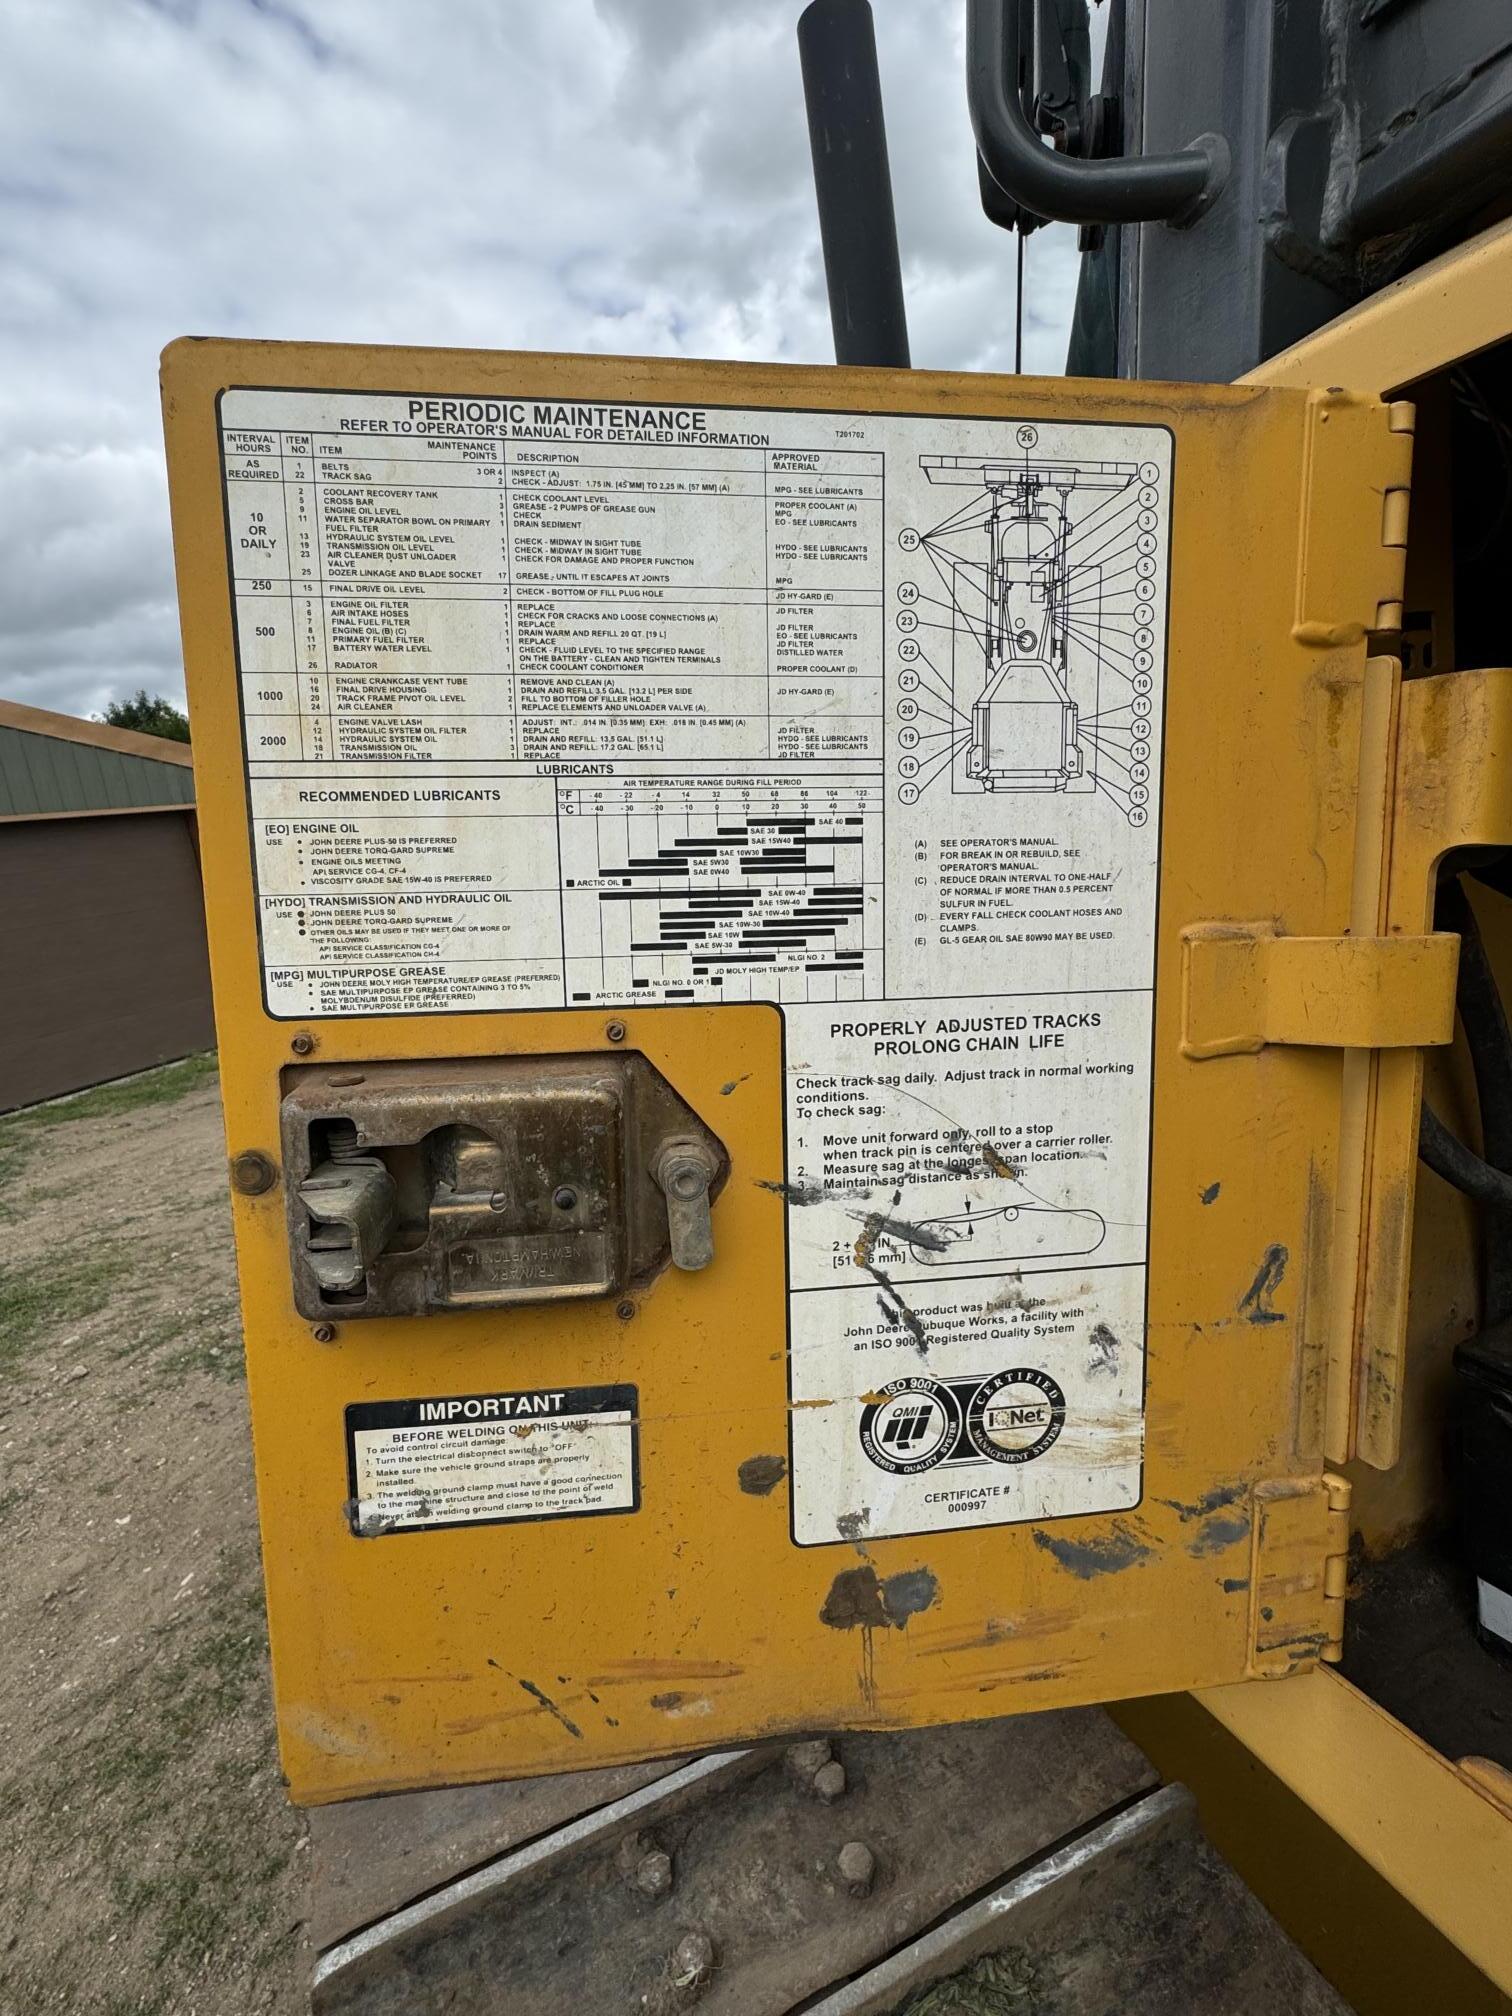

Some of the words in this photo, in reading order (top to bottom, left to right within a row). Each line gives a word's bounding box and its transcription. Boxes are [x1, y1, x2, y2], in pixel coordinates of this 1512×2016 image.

[408, 400, 525, 423] PERIODIC
[533, 405, 706, 430] MAINTENANCE
[339, 418, 389, 431] REFER
[391, 420, 412, 432] TO
[415, 421, 507, 436] OPERATOR'S
[511, 425, 571, 438] MANUAL
[575, 427, 603, 439] FOR
[607, 428, 673, 442] DETAILED
[677, 431, 769, 446] INFORMATION
[835, 430, 864, 438] T201702
[1022, 432, 1032, 441] 26
[226, 433, 275, 443] INTERVAL
[285, 436, 309, 444] ITEM
[235, 443, 271, 452] HOURS
[291, 445, 308, 453] NO.
[319, 445, 342, 454] ITEM
[427, 441, 495, 451] MAINTENANCE
[462, 451, 497, 460] POINTS
[516, 453, 579, 463] DESCRIPTION
[771, 453, 820, 462] APPROVED
[246, 459, 259, 467] AS
[773, 461, 817, 471] MATERIAL
[228, 469, 279, 479] REQUIRED
[321, 472, 351, 480] TRACK
[353, 472, 372, 480] SAG
[323, 488, 364, 496] COOLANT
[366, 489, 413, 497] RECOVERY
[415, 490, 438, 498] TANK
[512, 493, 541, 501] CHECK
[542, 494, 582, 502] COOLANT
[584, 495, 609, 503] LEVEL
[1146, 493, 1151, 502] 2
[324, 506, 356, 514] ENGINE
[374, 507, 401, 515] LEVEL
[774, 501, 806, 509] PROPER
[807, 502, 844, 510] COOLANT
[846, 503, 857, 511] (A)
[250, 512, 263, 522] 10
[248, 525, 267, 535] OR
[240, 538, 276, 549] DAILY
[904, 535, 915, 544] 25
[251, 580, 271, 591] 250
[329, 584, 354, 592] FINAL
[355, 585, 381, 593] DRIVE
[399, 585, 425, 593] LEVEL
[902, 589, 914, 598] 24
[255, 626, 275, 636] 500
[903, 645, 914, 655] 22
[334, 661, 377, 669] RADIATOR
[257, 691, 283, 700] 1000
[1135, 725, 1146, 733] 12
[260, 736, 286, 745] 2000
[536, 764, 614, 774] LUBRICANTS
[298, 790, 409, 802] RECOMMENDED
[413, 789, 500, 801] LUBRICANTS
[1133, 812, 1143, 821] 16
[265, 824, 289, 836] [EO]
[292, 824, 337, 833] ENGINE
[339, 823, 359, 833] OIL
[914, 839, 927, 849] (A)
[940, 839, 957, 847] SEE
[959, 838, 1017, 846] OPERATOR'S
[264, 897, 306, 909] [HYDO]
[308, 895, 395, 906] TRANSMISSION
[398, 895, 422, 904] AND
[425, 894, 490, 903] HYDRAULIC
[493, 893, 512, 902] OIL
[914, 937, 926, 946] (E)
[939, 936, 960, 944] GL-5
[961, 935, 987, 943] GEAR
[1005, 934, 1023, 942] SAE
[1025, 933, 1052, 941] 80W90
[1054, 932, 1073, 940] MAY
[1075, 932, 1087, 940] BE
[1089, 931, 1113, 939] USED.
[270, 970, 304, 983] [MPG]
[306, 967, 396, 979] MULTIPURPOSE
[399, 966, 446, 976] GREASE
[625, 990, 656, 998] GREASE
[830, 1020, 926, 1037] PROPERLY
[935, 1016, 1027, 1033] ADJUSTED
[1032, 1013, 1100, 1029] TRACKS
[874, 1038, 960, 1056] PROLONG
[966, 1035, 1018, 1051] CHAIN
[1029, 1033, 1064, 1048] LIFE
[796, 1077, 836, 1090] Check
[840, 1075, 875, 1087] track
[878, 1074, 900, 1087] sag
[904, 1071, 937, 1086] daily.
[944, 1069, 985, 1081] Adjust
[988, 1068, 1020, 1079] track
[1024, 1068, 1035, 1077] in
[1039, 1066, 1081, 1076] normal
[1085, 1064, 1134, 1076] working
[796, 1092, 868, 1103] conditions.
[797, 1107, 812, 1119] To
[815, 1105, 854, 1117] check
[858, 1105, 886, 1117] sag:
[797, 1137, 808, 1148] 1.
[823, 1134, 857, 1146] Move
[861, 1132, 886, 1143] unit
[889, 1130, 938, 1143] forward
[942, 1127, 972, 1143] only,
[976, 1126, 996, 1137] roll
[999, 1125, 1012, 1135] to
[1015, 1126, 1022, 1135] a
[1026, 1124, 1053, 1134] stop
[912, 1305, 957, 1318] product
[961, 1303, 982, 1312] was
[843, 1325, 873, 1338] John
[969, 1316, 1008, 1328] Works,
[1021, 1310, 1057, 1324] facility
[1061, 1308, 1084, 1319] with
[871, 1339, 892, 1350] ISO
[926, 1331, 987, 1346] Registered
[991, 1326, 1030, 1340] Quality
[1034, 1323, 1075, 1337] System
[883, 1379, 906, 1396] ISO
[910, 1378, 938, 1394] 9001
[977, 1372, 1060, 1405] CERTIFIED
[419, 1394, 565, 1421] IMPORTANT
[893, 1406, 919, 1417] QMI
[392, 1430, 444, 1443] BEFORE
[447, 1426, 505, 1439] WELDING
[378, 1443, 405, 1454] avoid
[406, 1441, 438, 1452] control
[440, 1439, 468, 1450] circuit
[924, 1486, 1000, 1503] CERTIFICATE
[1003, 1486, 1010, 1495] #
[947, 1500, 986, 1512] 000997
